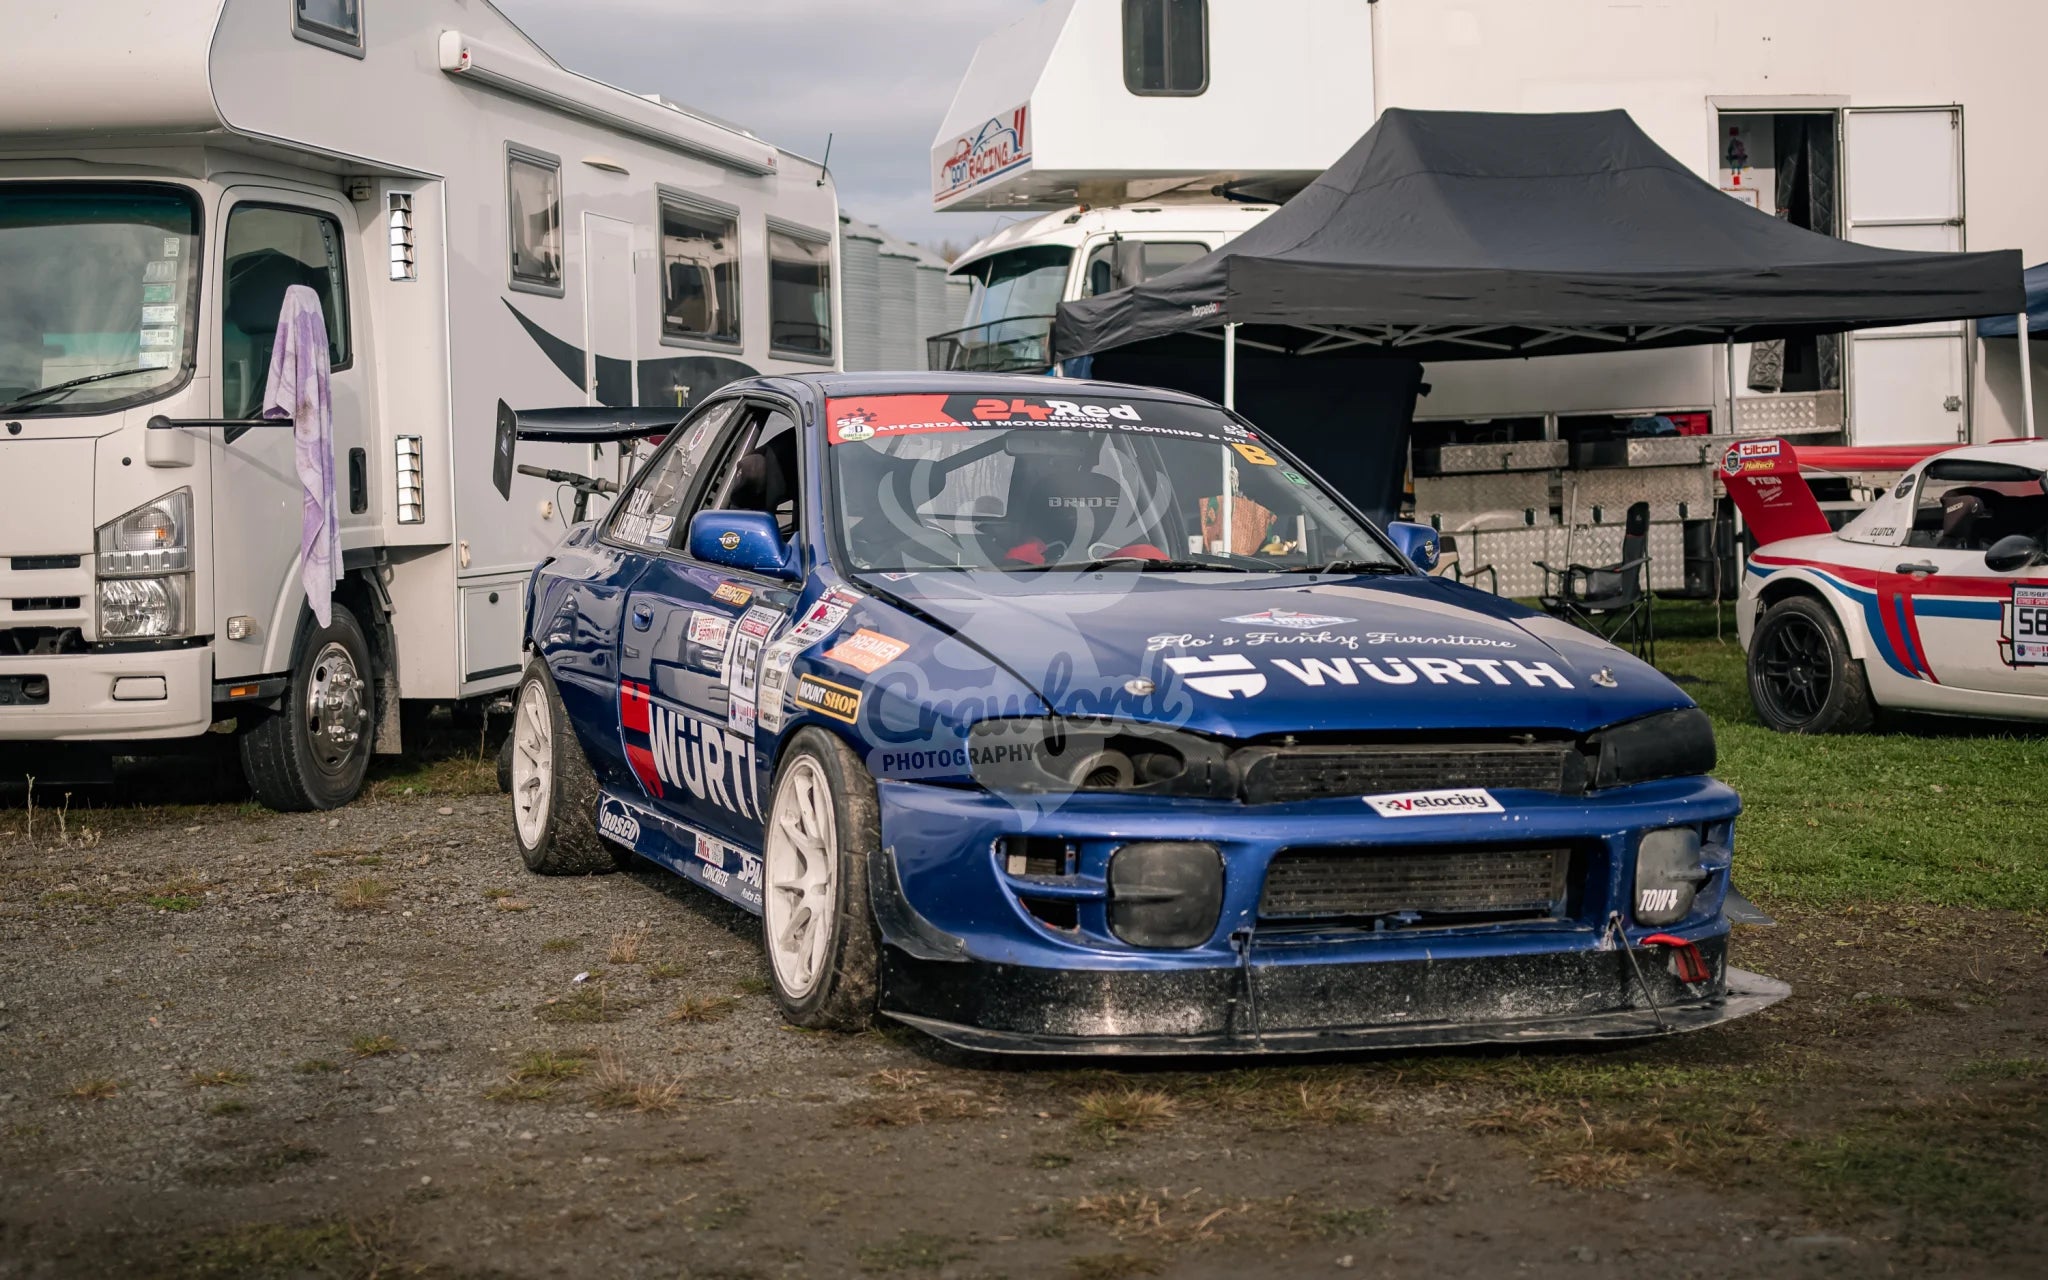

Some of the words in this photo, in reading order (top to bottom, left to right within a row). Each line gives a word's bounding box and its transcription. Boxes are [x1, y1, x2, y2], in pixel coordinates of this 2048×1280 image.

[1050, 415, 1108, 423] RACING
[876, 420, 991, 432] AFFORDABLE
[995, 420, 1114, 430] MOTORSPORT
[1118, 424, 1204, 438] CLOTHING
[1223, 436, 1246, 444] KIT
[1230, 443, 1277, 466] B
[1742, 444, 1778, 456] tilton
[1048, 496, 1120, 508] BRIDE
[850, 634, 902, 661] PREMIER
[1366, 631, 1517, 649] Furniture
[1269, 657, 1576, 689] WÜRTH
[800, 680, 826, 704] MOUNT
[823, 690, 858, 715] SHOP
[1393, 793, 1489, 811] Velocity
[702, 863, 730, 888] CONCRETE
[1638, 889, 1671, 912] TOW
